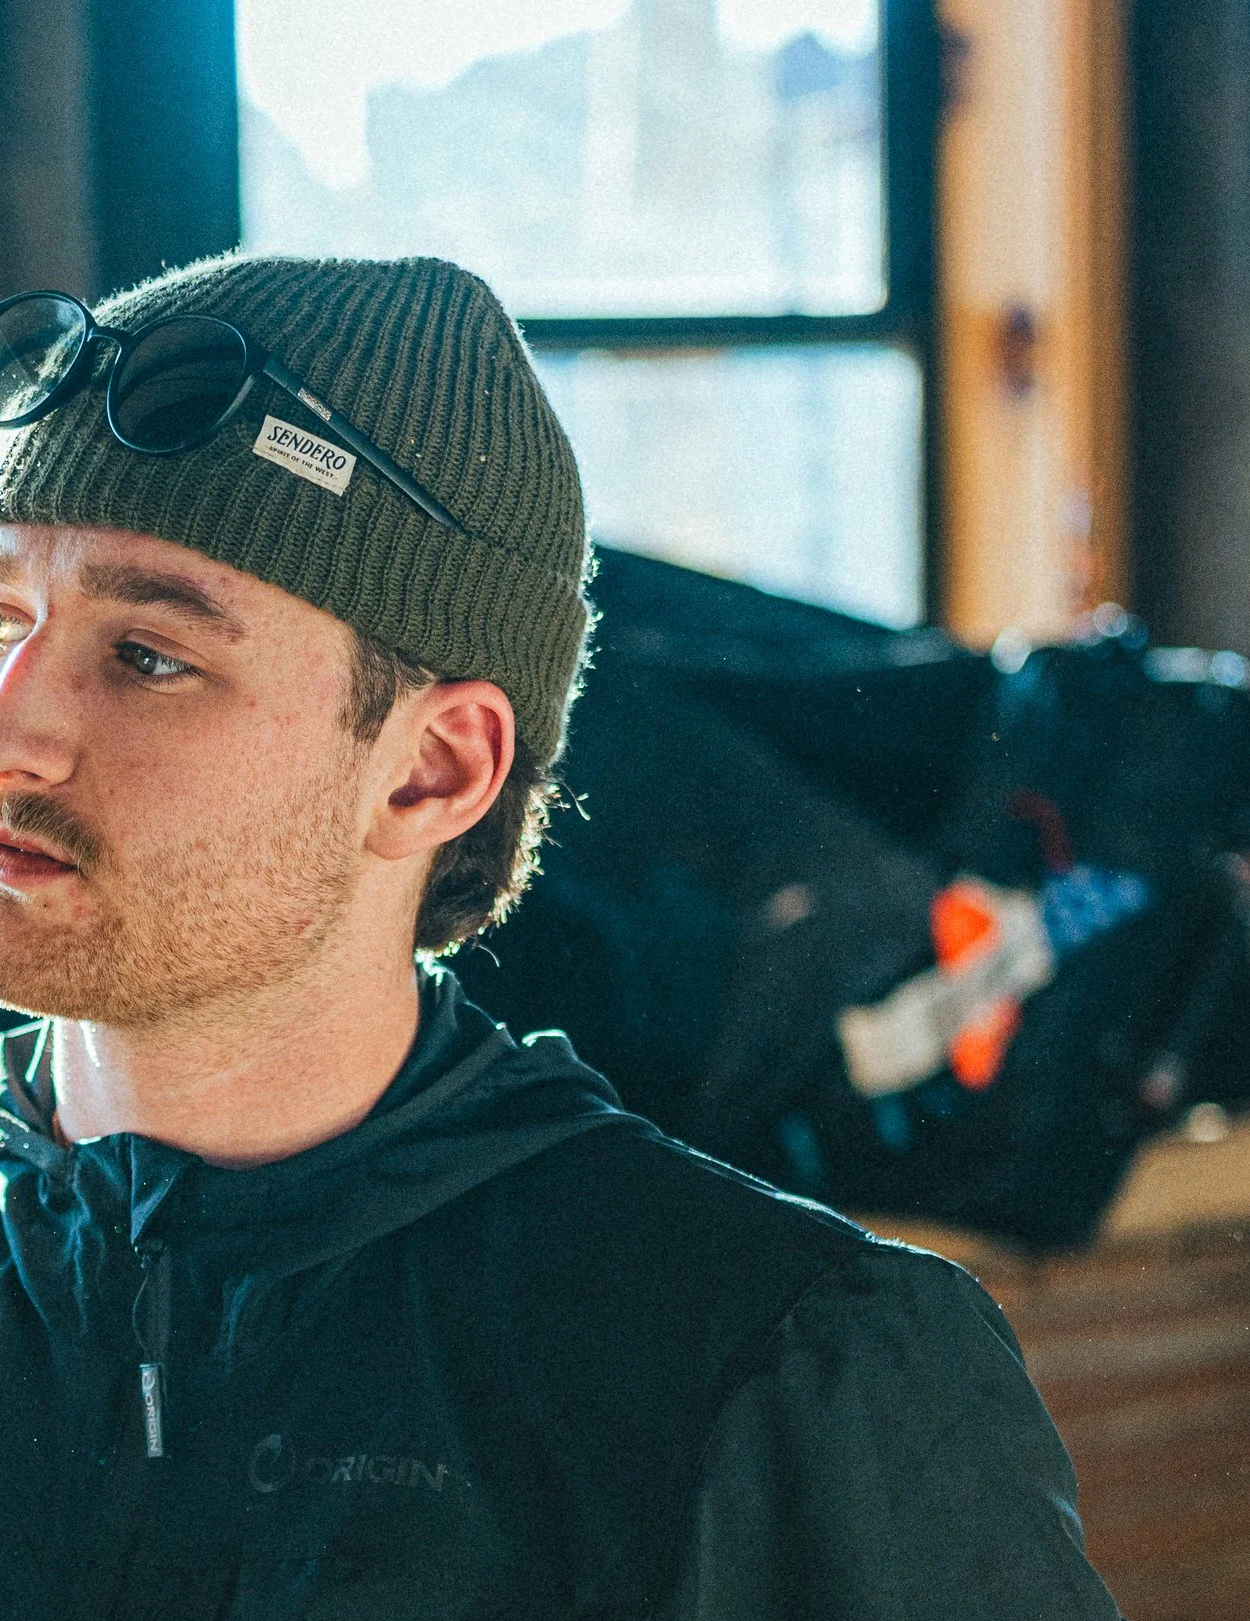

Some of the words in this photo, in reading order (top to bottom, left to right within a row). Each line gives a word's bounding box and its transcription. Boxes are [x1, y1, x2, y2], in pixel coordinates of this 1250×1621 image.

[267, 425, 347, 470] SENDERO
[269, 446, 290, 458] SPIRIT
[291, 455, 300, 463] OF
[302, 460, 313, 469] THE
[145, 1393, 157, 1451] ORIGIN
[305, 1455, 447, 1492] ORIGIN
